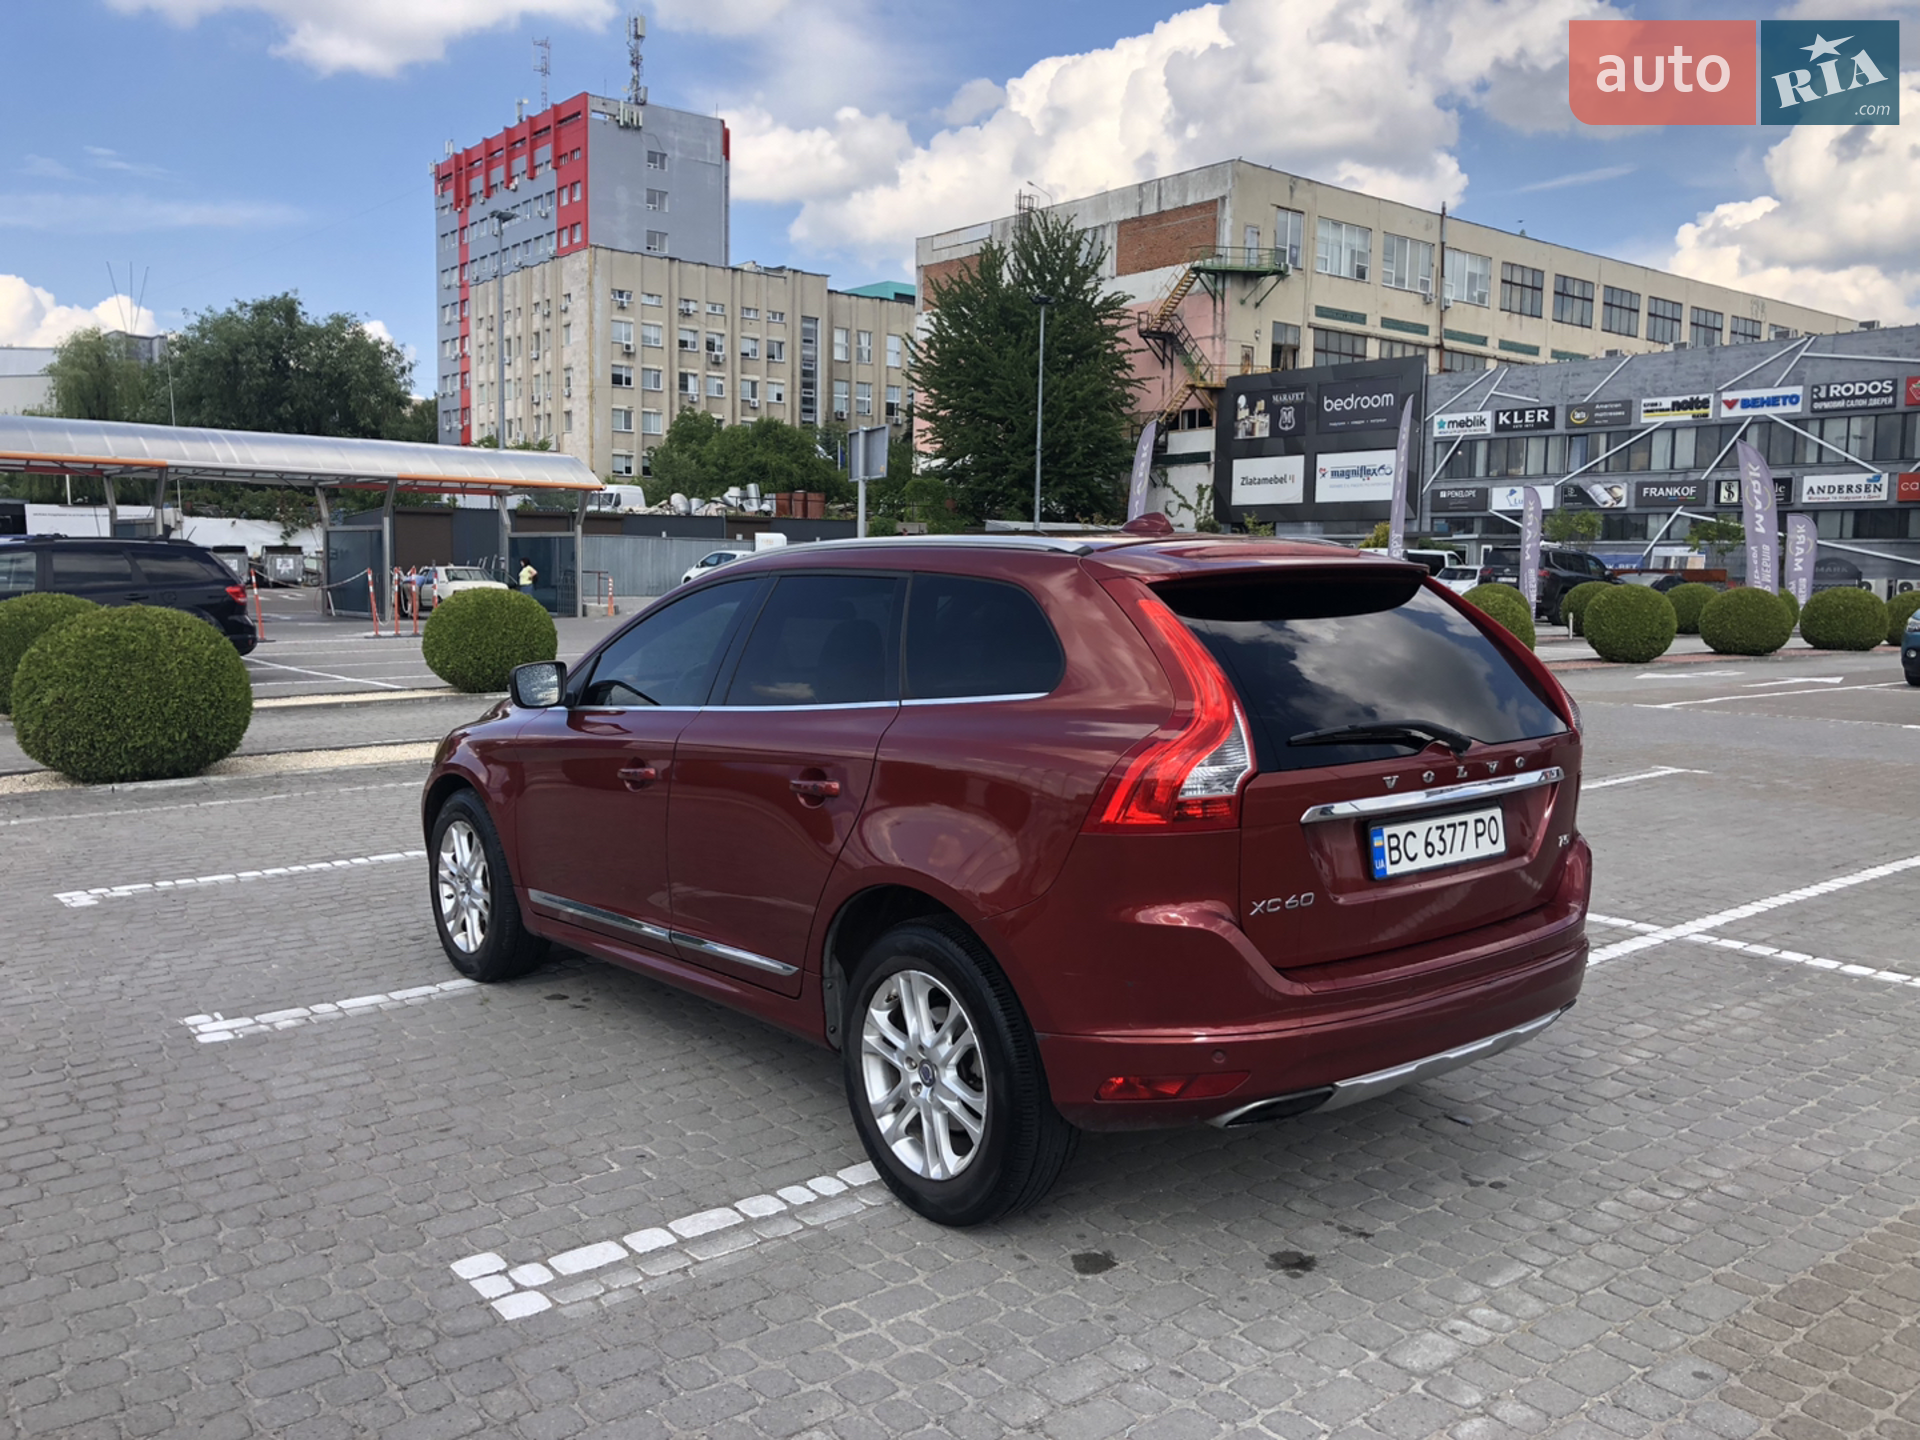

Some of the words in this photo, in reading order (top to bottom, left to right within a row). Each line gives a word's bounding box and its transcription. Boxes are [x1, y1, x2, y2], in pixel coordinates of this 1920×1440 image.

[1829, 380, 1893, 397] RODOS
[1323, 392, 1394, 412] bedroom
[1447, 415, 1487, 429] meblik
[1498, 409, 1550, 425] KLER
[1240, 474, 1287, 486] Zlatamebel
[1331, 465, 1378, 480] magniflex
[1643, 485, 1697, 497] FRANKOF
[1806, 483, 1883, 496] ANDERSEN
[1382, 756, 1526, 789] VOLVO
[1387, 830, 1418, 866] BC
[1424, 821, 1468, 857] 6377
[1474, 815, 1499, 849] PO
[1375, 859, 1385, 870] UA
[1249, 892, 1315, 915] XC60
